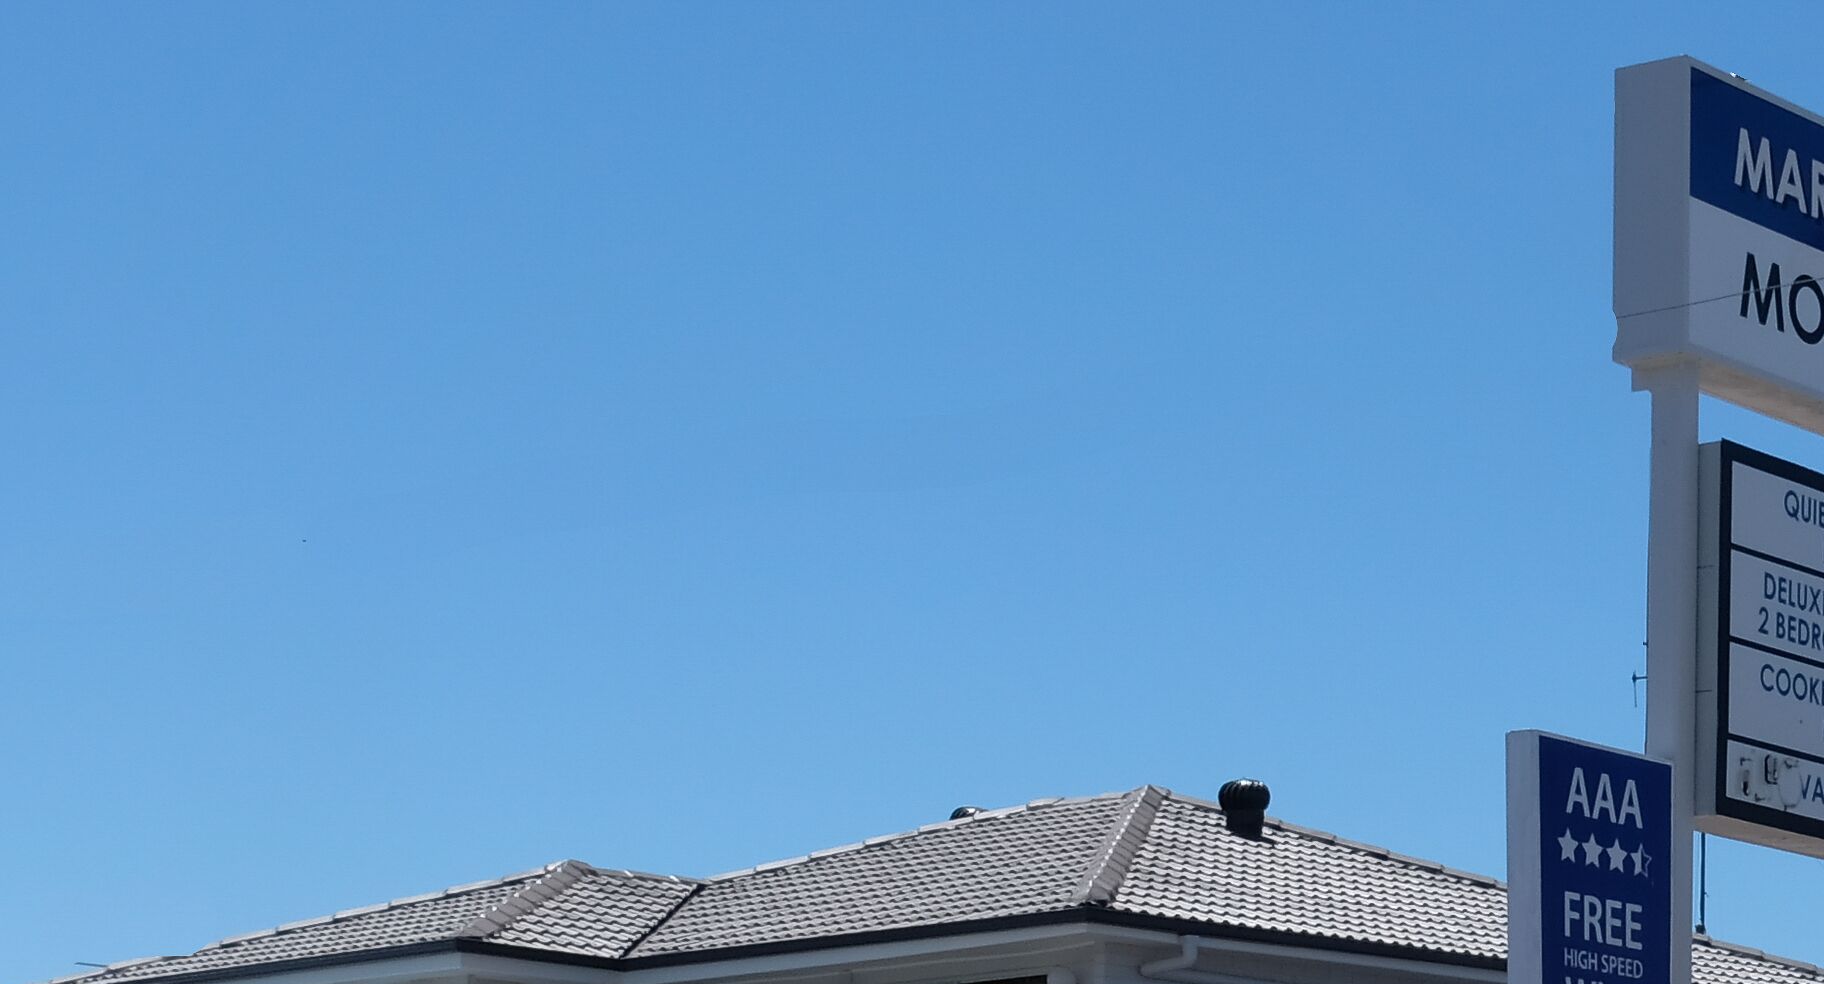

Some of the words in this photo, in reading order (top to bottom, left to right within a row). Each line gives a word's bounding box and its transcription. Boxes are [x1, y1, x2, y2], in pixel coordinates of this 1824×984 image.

[1758, 606, 1769, 635] 2
[1565, 767, 1644, 829] AAA
[1563, 890, 1643, 951] FREE
[1563, 947, 1598, 972] HIGH
[1601, 953, 1644, 979] SPEED
